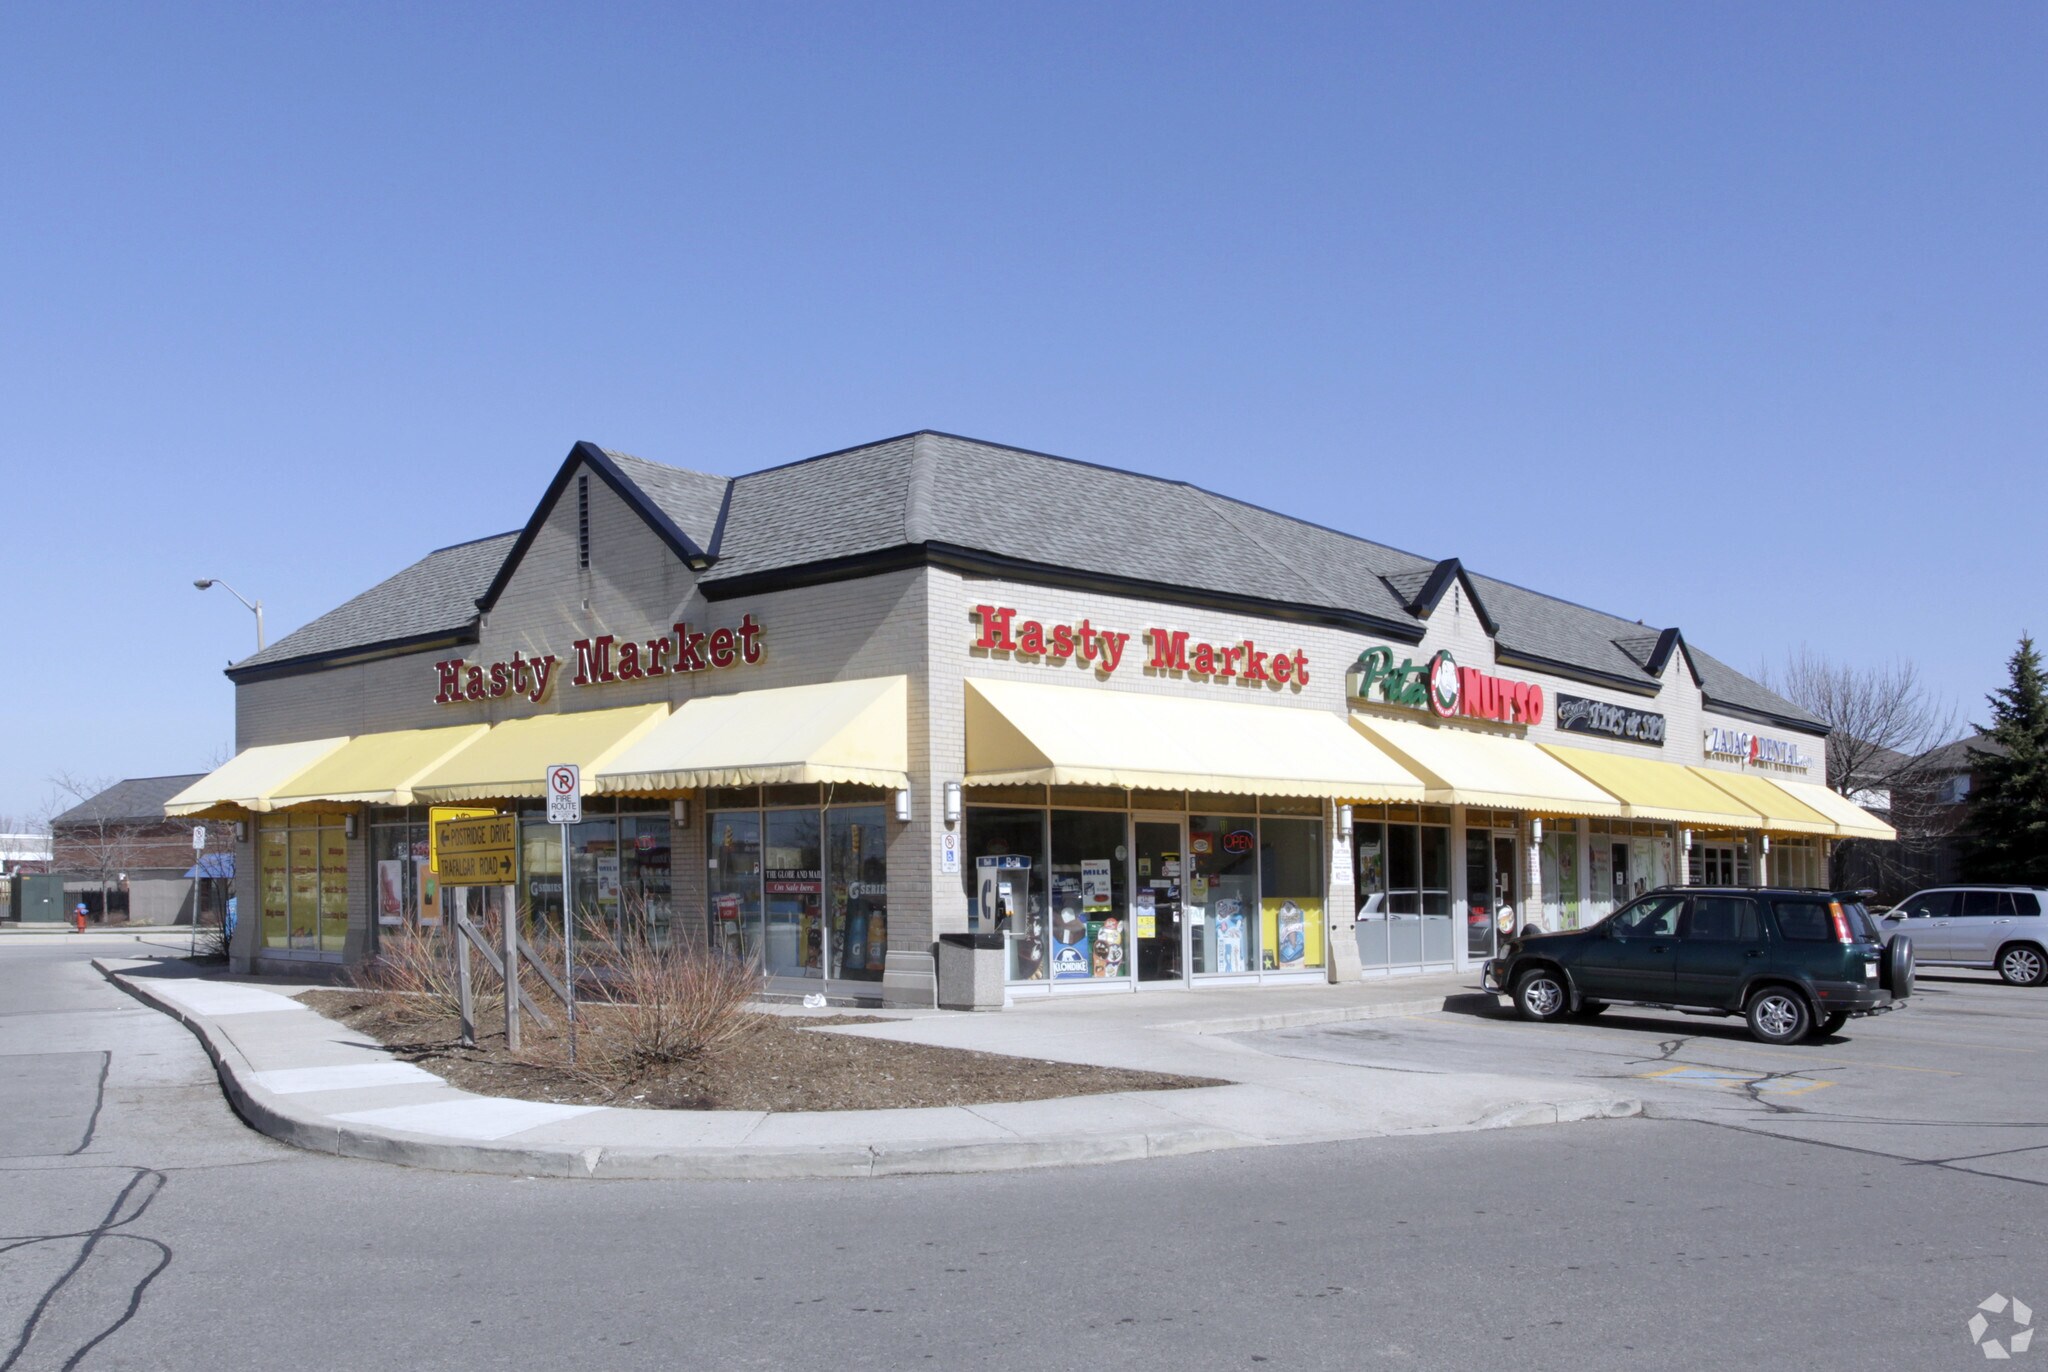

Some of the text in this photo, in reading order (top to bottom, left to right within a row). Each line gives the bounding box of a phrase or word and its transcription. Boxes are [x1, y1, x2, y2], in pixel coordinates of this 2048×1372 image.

[974, 603, 1310, 686] Hasty Market
[433, 613, 761, 704] Hasty Market
[1356, 645, 1429, 706] Pita
[1460, 666, 1544, 725] NUTSO
[1712, 727, 1748, 755] ZAJAC
[1758, 736, 1800, 766] DENTAL
[551, 802, 577, 811] ROUTE
[555, 794, 572, 803] FIRE
[450, 822, 512, 847] POSTRIDGE DRIVE
[1223, 833, 1254, 849] OPEN
[440, 856, 498, 877] TRAFALGAR ROAD
[1005, 856, 1021, 868] Bell
[765, 870, 777, 879] THE
[777, 870, 796, 879] GLOBE
[796, 870, 808, 879] AND
[1083, 868, 1109, 876] MILK
[530, 881, 539, 897] G
[774, 882, 785, 891] On
[785, 883, 799, 891] Sale
[849, 881, 887, 899] G SERIE
[1053, 960, 1088, 975] KLONDIKE
